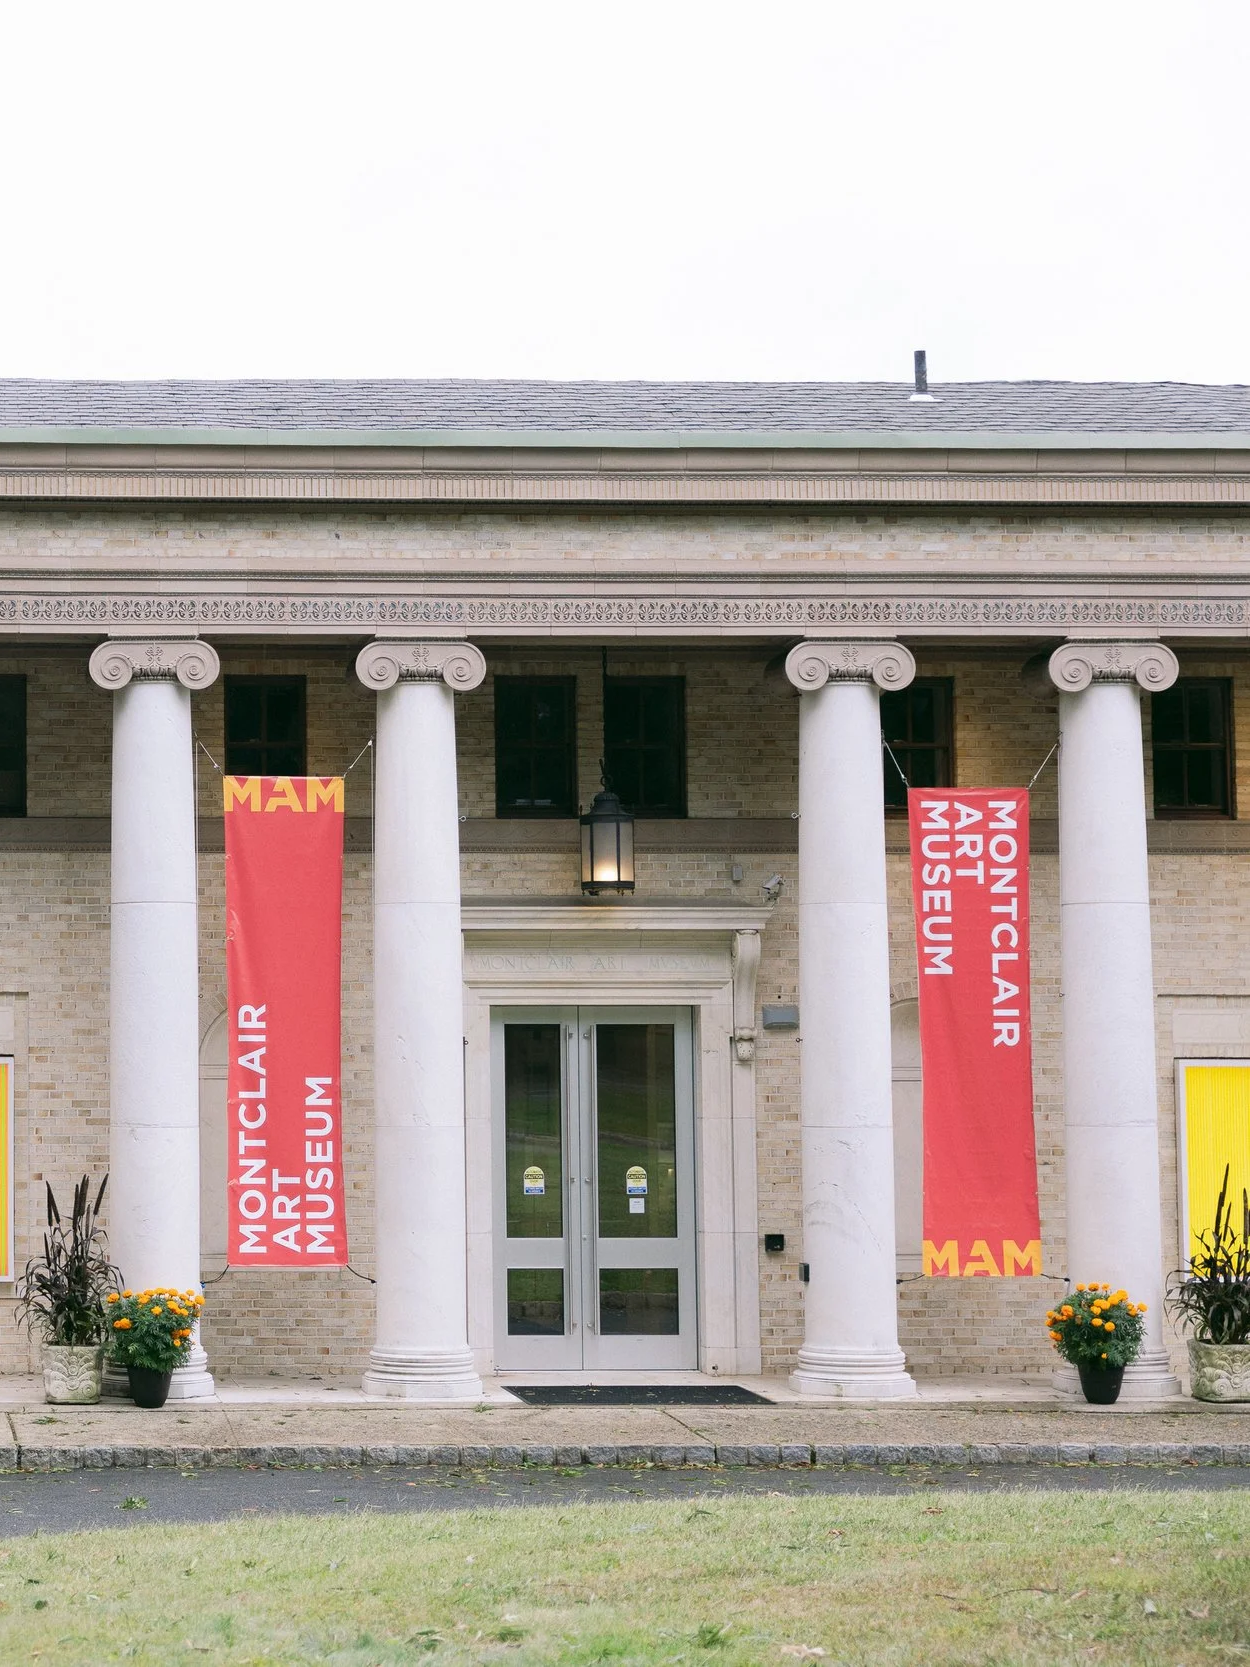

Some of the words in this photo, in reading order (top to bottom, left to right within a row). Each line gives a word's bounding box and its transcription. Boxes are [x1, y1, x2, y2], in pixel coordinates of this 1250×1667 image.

[223, 777, 345, 812] MAM
[953, 801, 985, 885] ART
[920, 800, 953, 975] MUSEUM
[988, 800, 1020, 1047] MONTCLAIR
[480, 955, 575, 970] MONTCLAIR
[593, 955, 626, 970] ART
[238, 1004, 268, 1254] MONTCLAIR
[305, 1077, 335, 1254] MUSEUM
[272, 1168, 302, 1253] ART
[923, 1240, 1042, 1277] MAM
